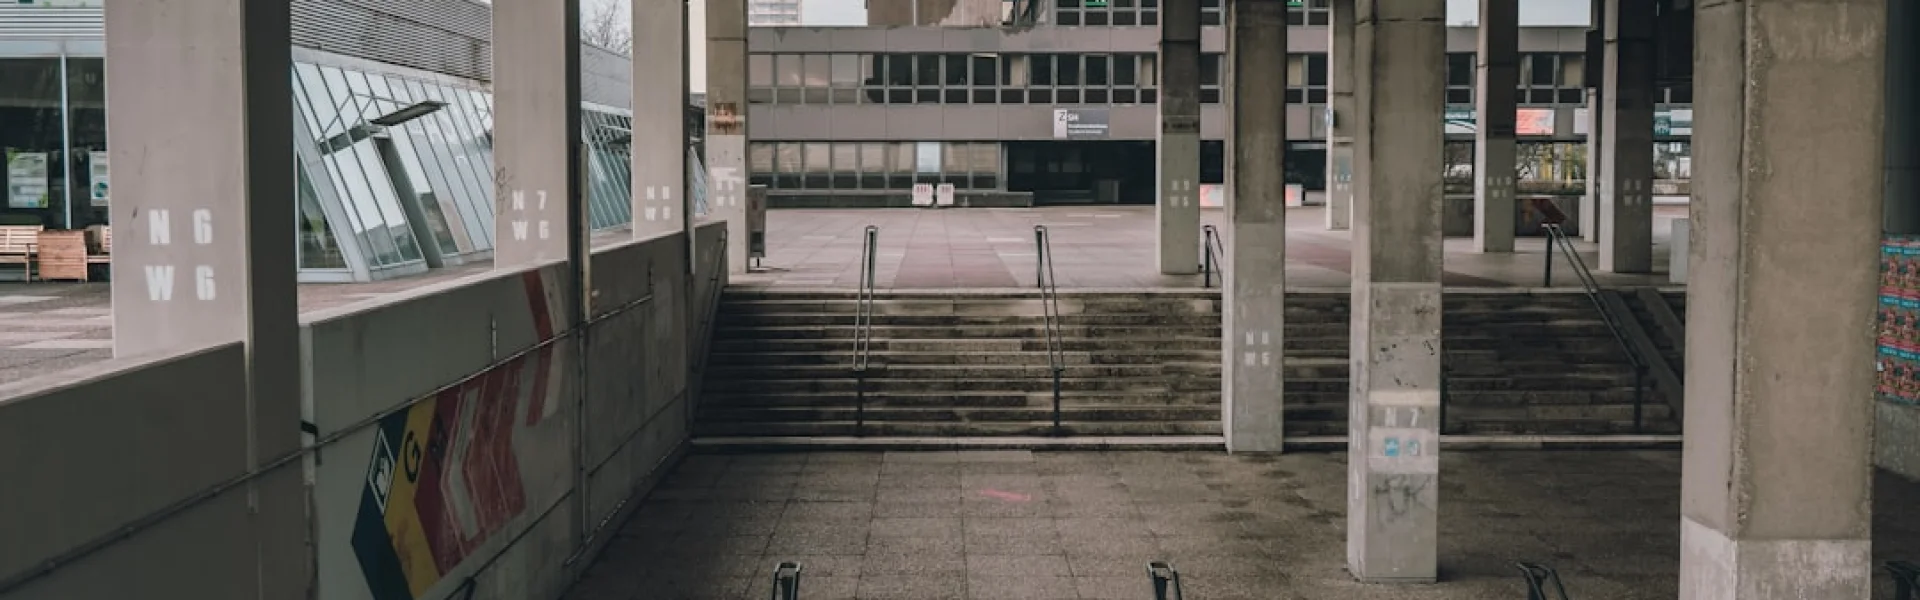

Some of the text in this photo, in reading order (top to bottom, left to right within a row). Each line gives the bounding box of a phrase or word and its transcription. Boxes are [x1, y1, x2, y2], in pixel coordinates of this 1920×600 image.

[512, 189, 525, 211] N
[536, 189, 547, 211] 7
[148, 208, 213, 245] N 6
[511, 221, 529, 241] W
[145, 264, 216, 301] W 6
[403, 430, 420, 483] G
